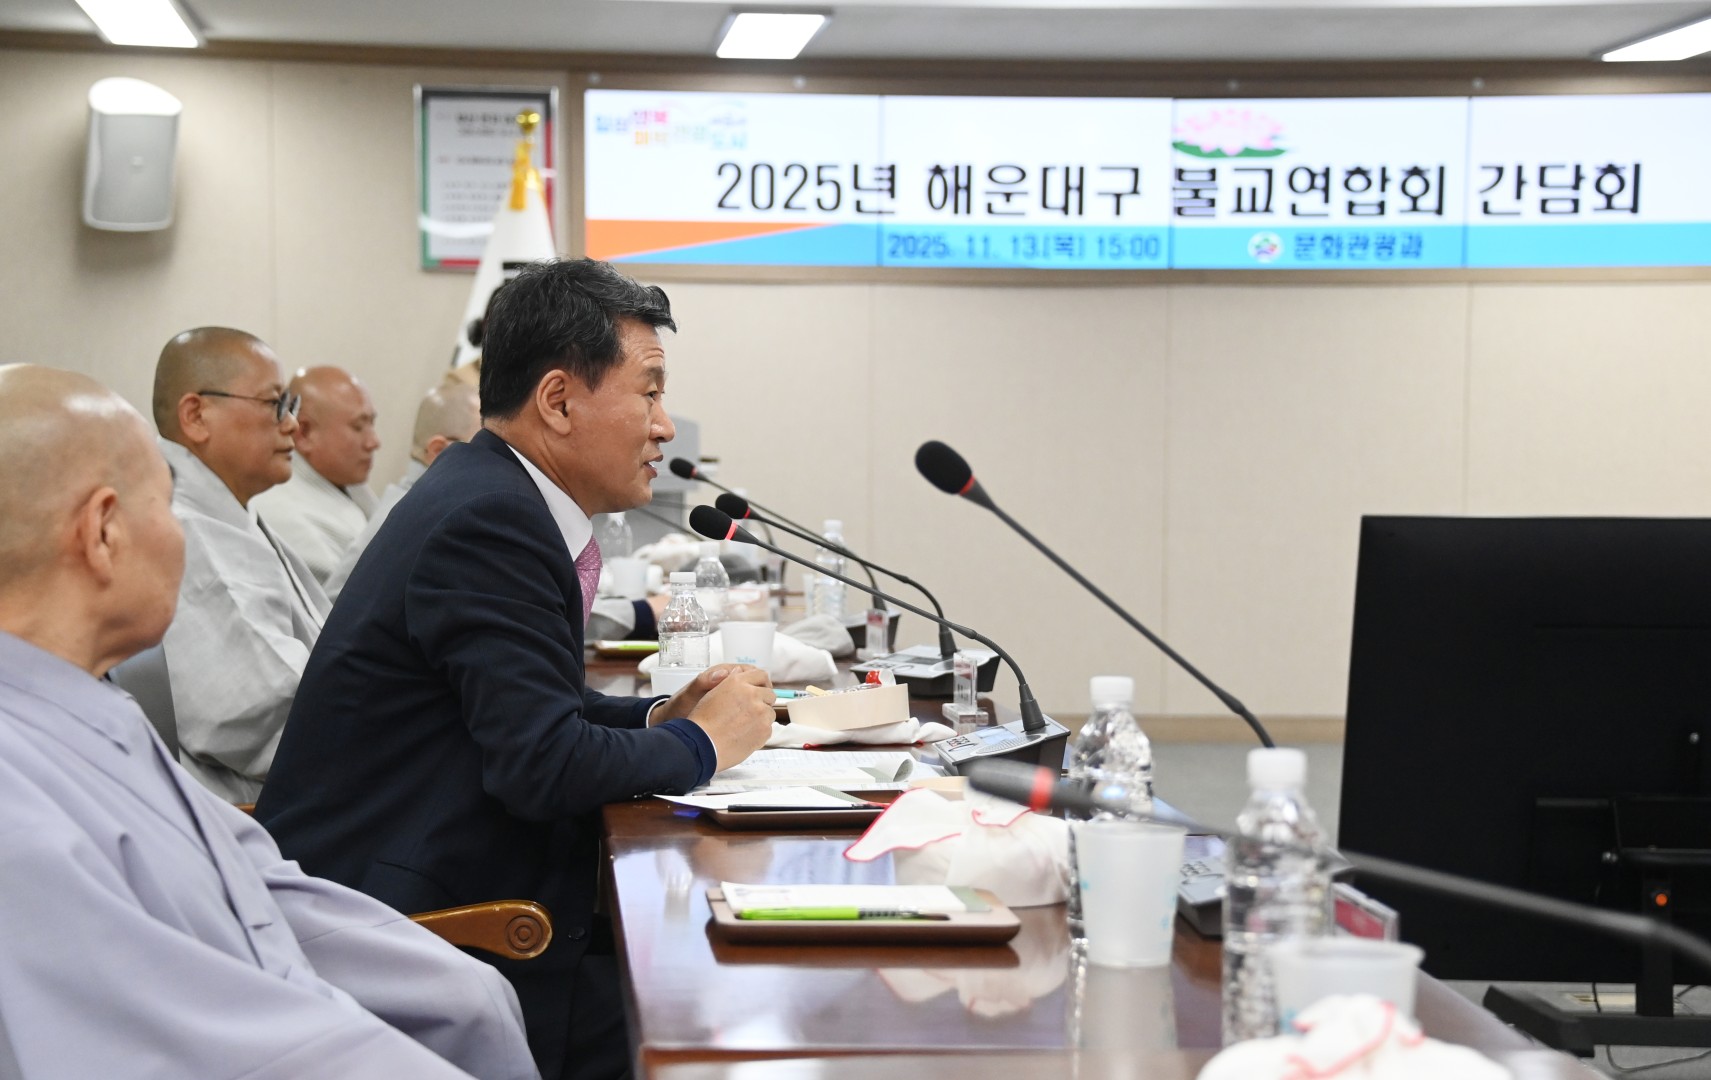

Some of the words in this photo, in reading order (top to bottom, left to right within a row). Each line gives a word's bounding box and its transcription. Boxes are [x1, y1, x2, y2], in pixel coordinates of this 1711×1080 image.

[717, 163, 897, 214] 2025년
[927, 164, 1142, 216] 해운대구
[1173, 165, 1446, 217] 불교연합회
[1478, 163, 1643, 216] 간담회
[1096, 236, 1160, 261] 15:00
[1294, 232, 1423, 261] 문화관광과
